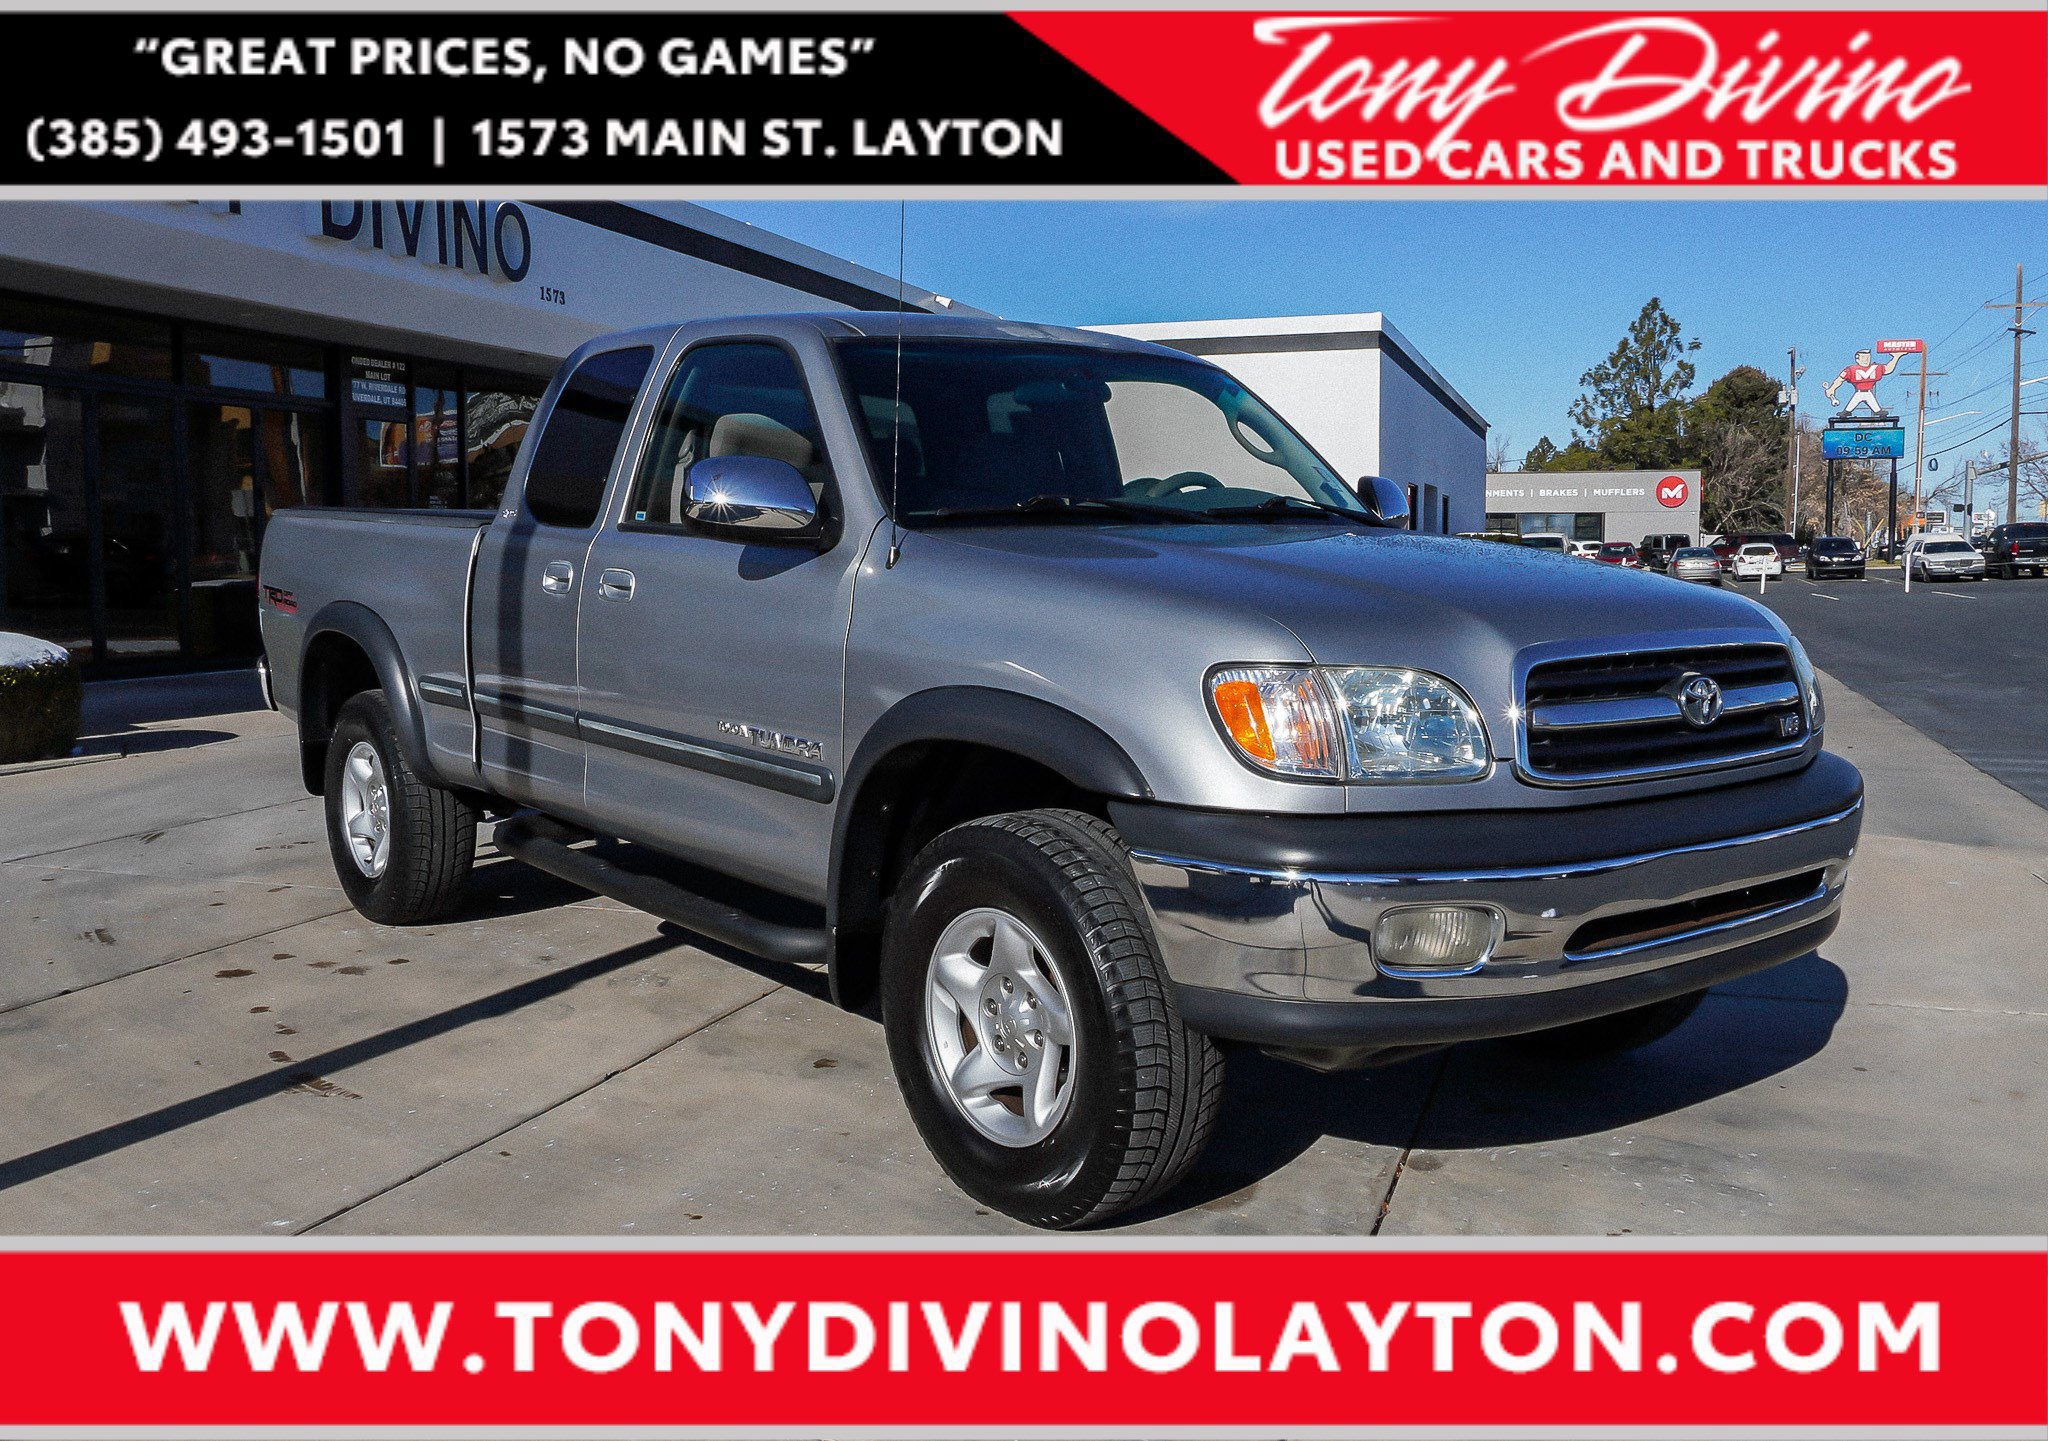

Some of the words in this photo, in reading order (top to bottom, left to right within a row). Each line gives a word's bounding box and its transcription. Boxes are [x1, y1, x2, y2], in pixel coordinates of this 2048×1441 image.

[539, 286, 566, 306] 1573
[370, 359, 391, 369] DEALER
[365, 370, 380, 380] MAIN
[380, 372, 391, 381] LOT
[1855, 433, 1873, 442] DC
[1871, 446, 1891, 455] AM
[1540, 489, 1579, 497] BRAKES
[1593, 488, 1646, 496] MUFFLERS
[262, 584, 283, 607] TRD
[748, 726, 824, 762] TUNDRA
